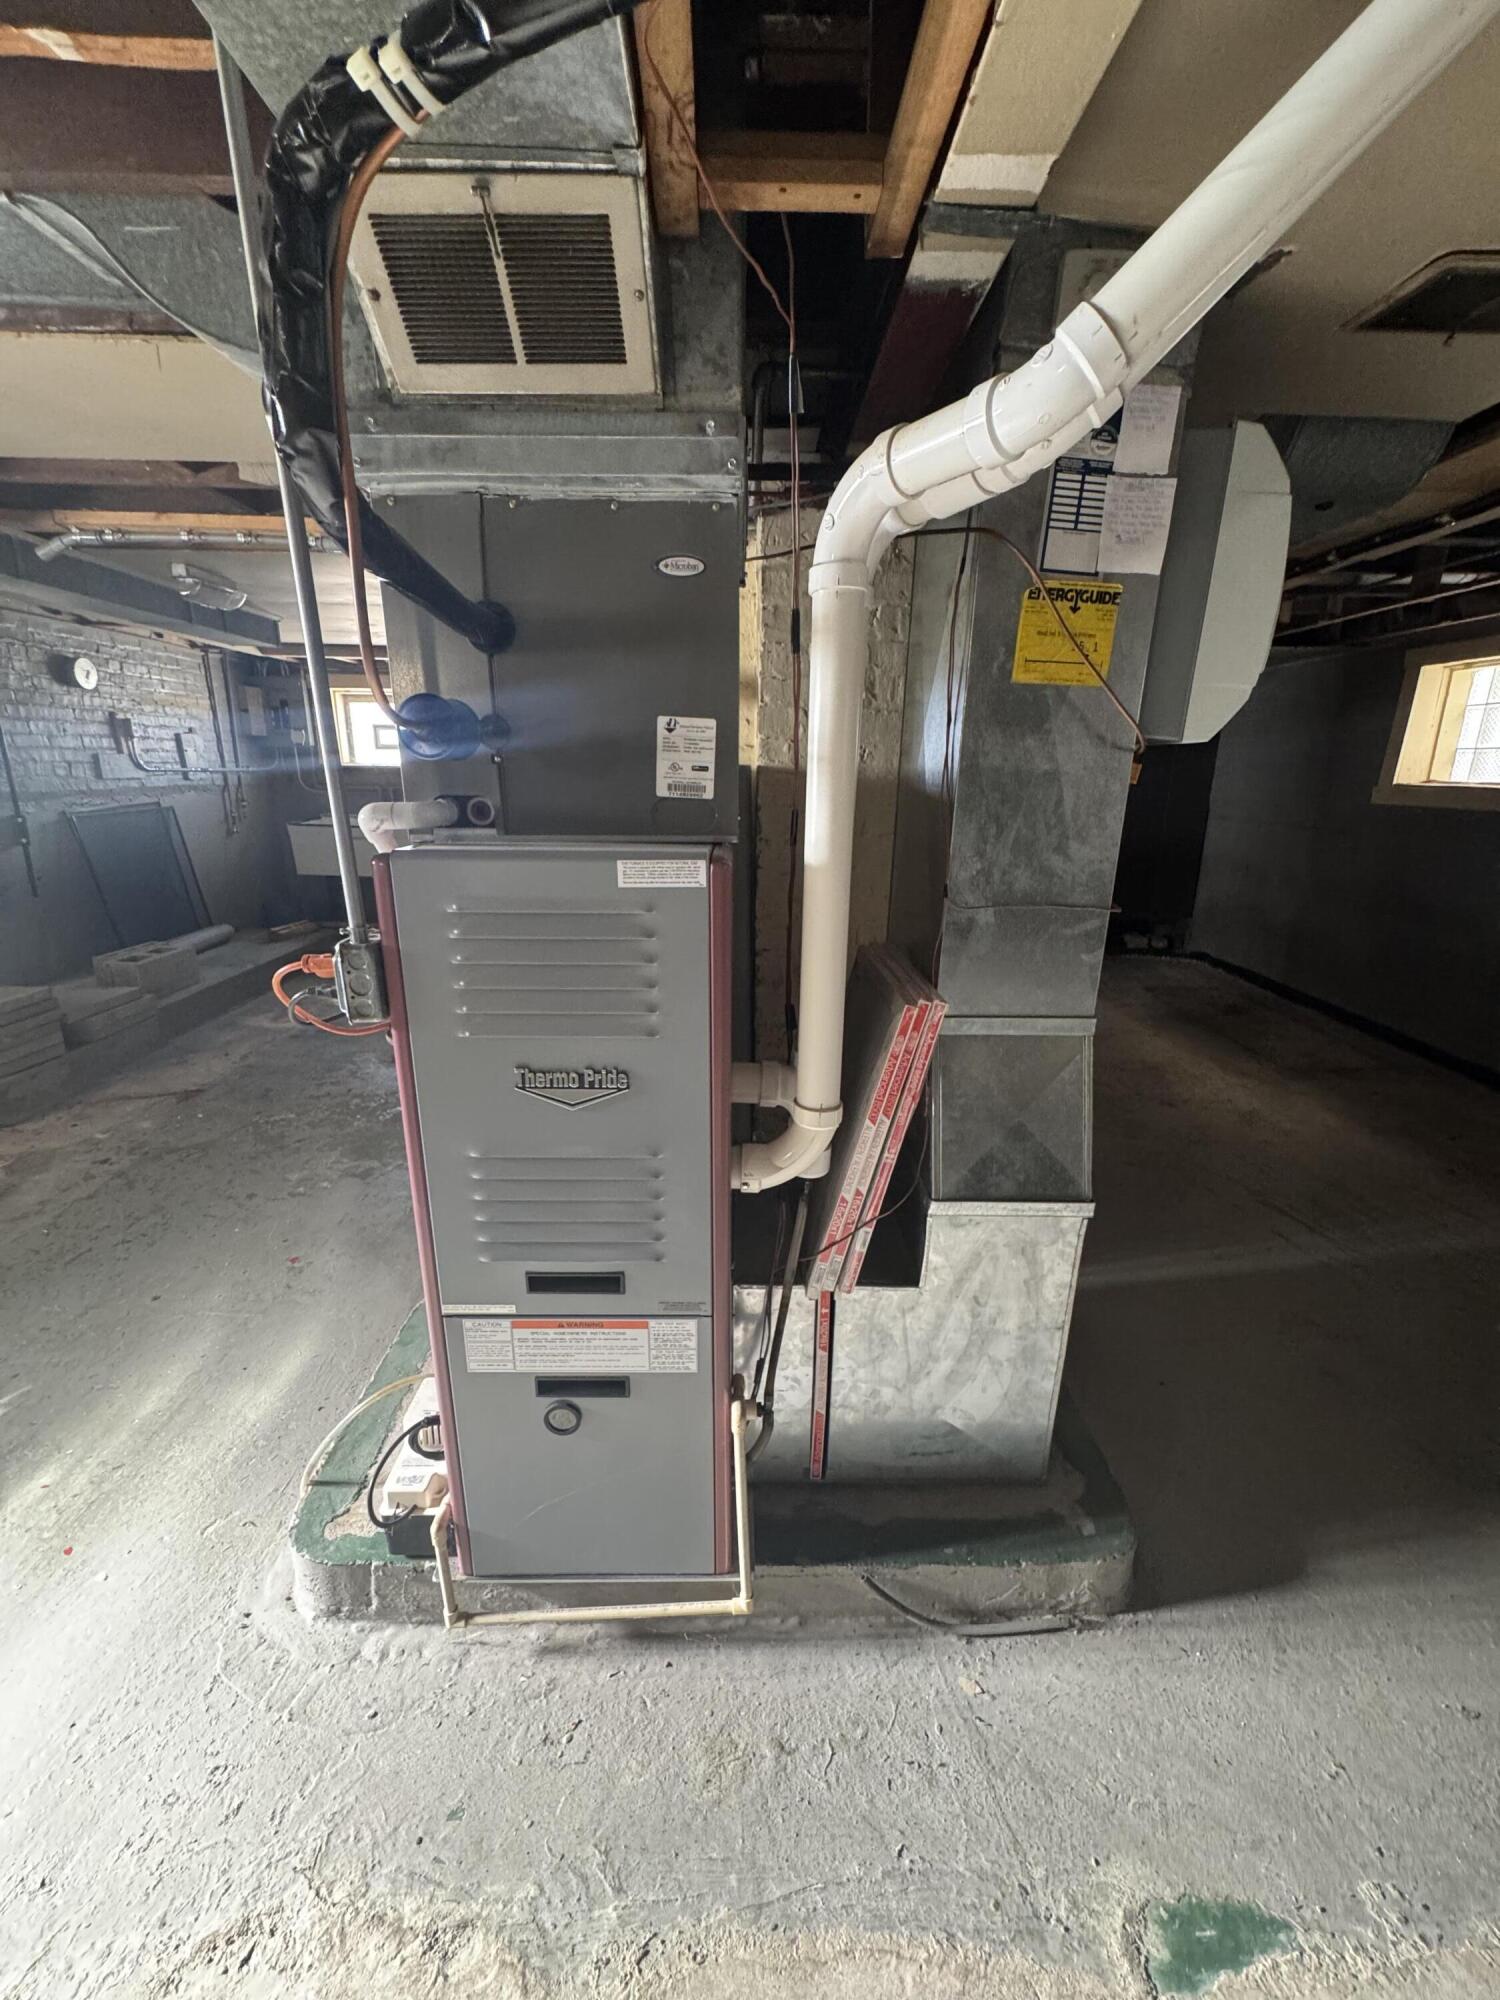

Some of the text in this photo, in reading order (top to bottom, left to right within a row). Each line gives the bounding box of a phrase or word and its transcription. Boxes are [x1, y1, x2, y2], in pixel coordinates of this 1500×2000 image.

[514, 1066, 628, 1089] Thermo Pride
[566, 1321, 604, 1329] WARNING
